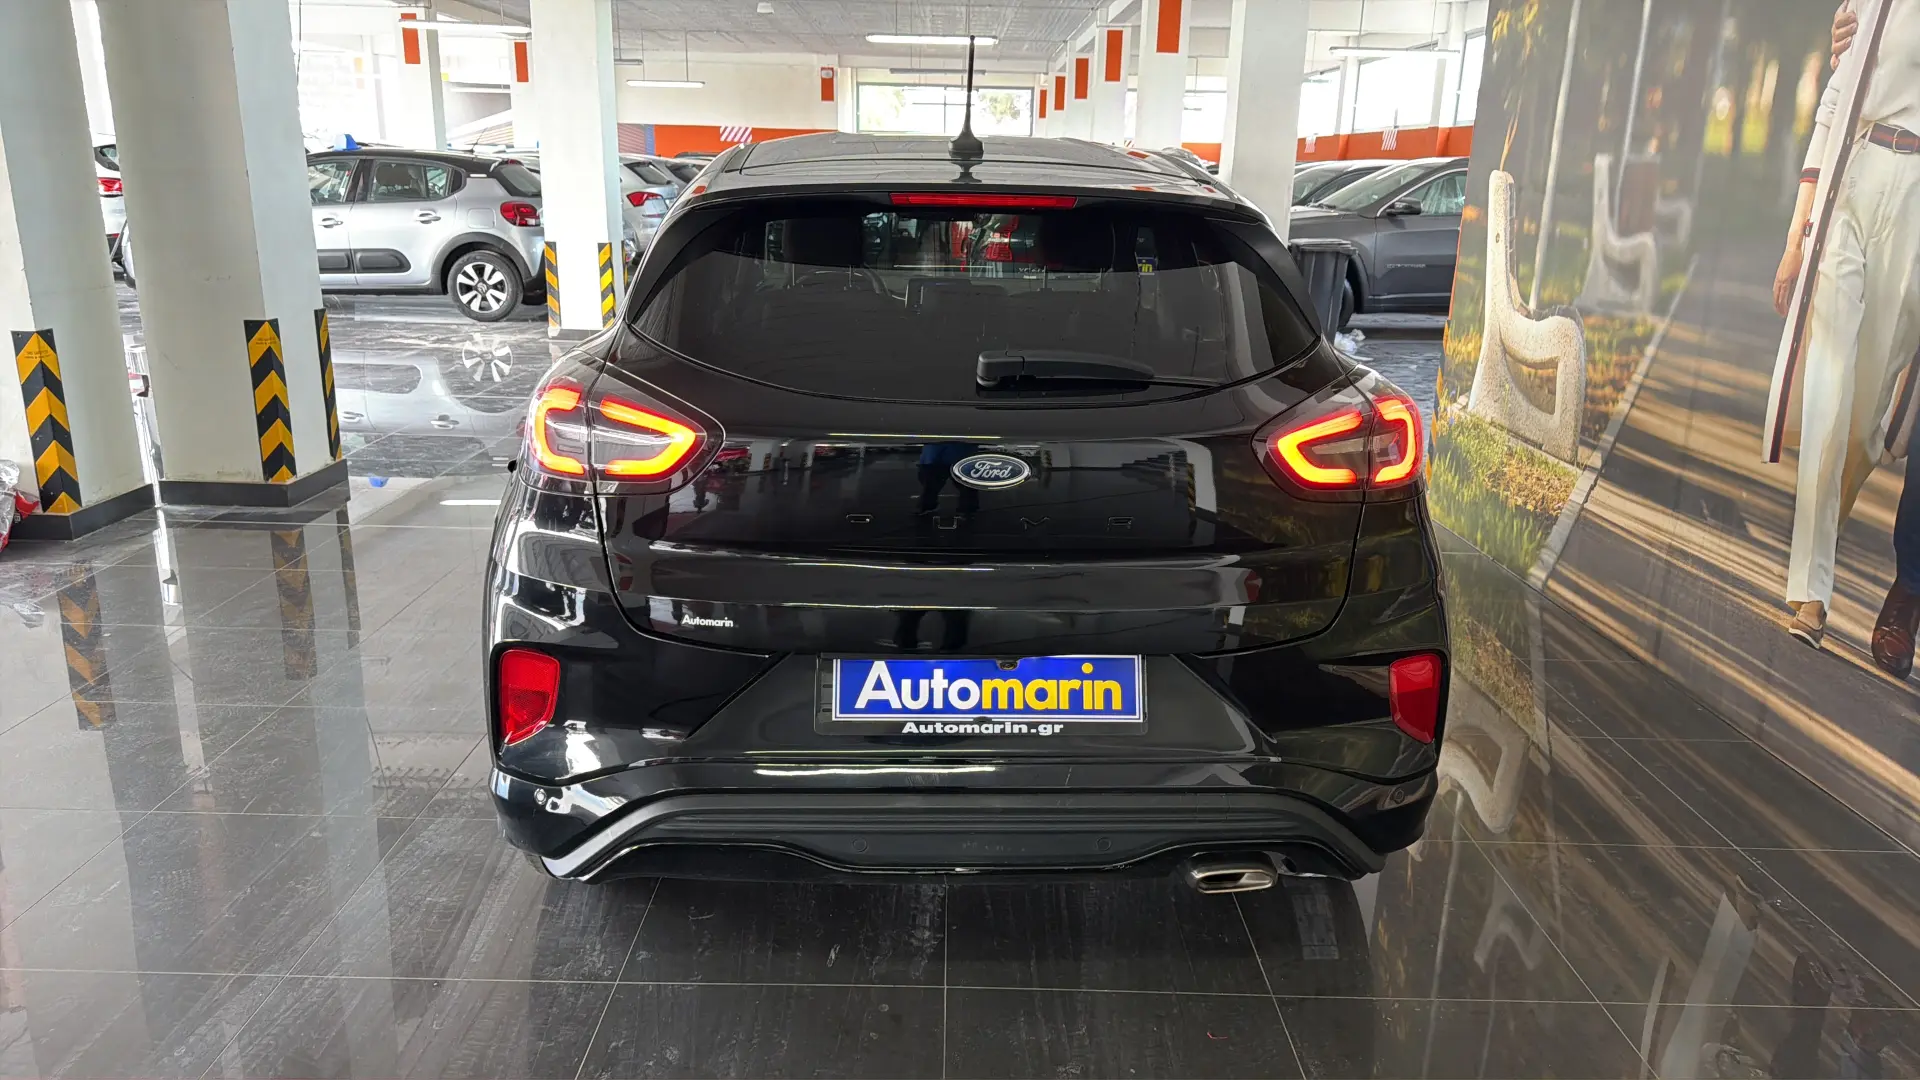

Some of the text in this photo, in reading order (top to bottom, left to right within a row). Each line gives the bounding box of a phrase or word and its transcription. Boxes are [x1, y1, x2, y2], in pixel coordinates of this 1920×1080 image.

[971, 461, 1012, 478] Ford
[681, 614, 734, 627] Automarin
[854, 660, 1122, 710] Automarin
[902, 721, 1064, 736] Automarin.gr
